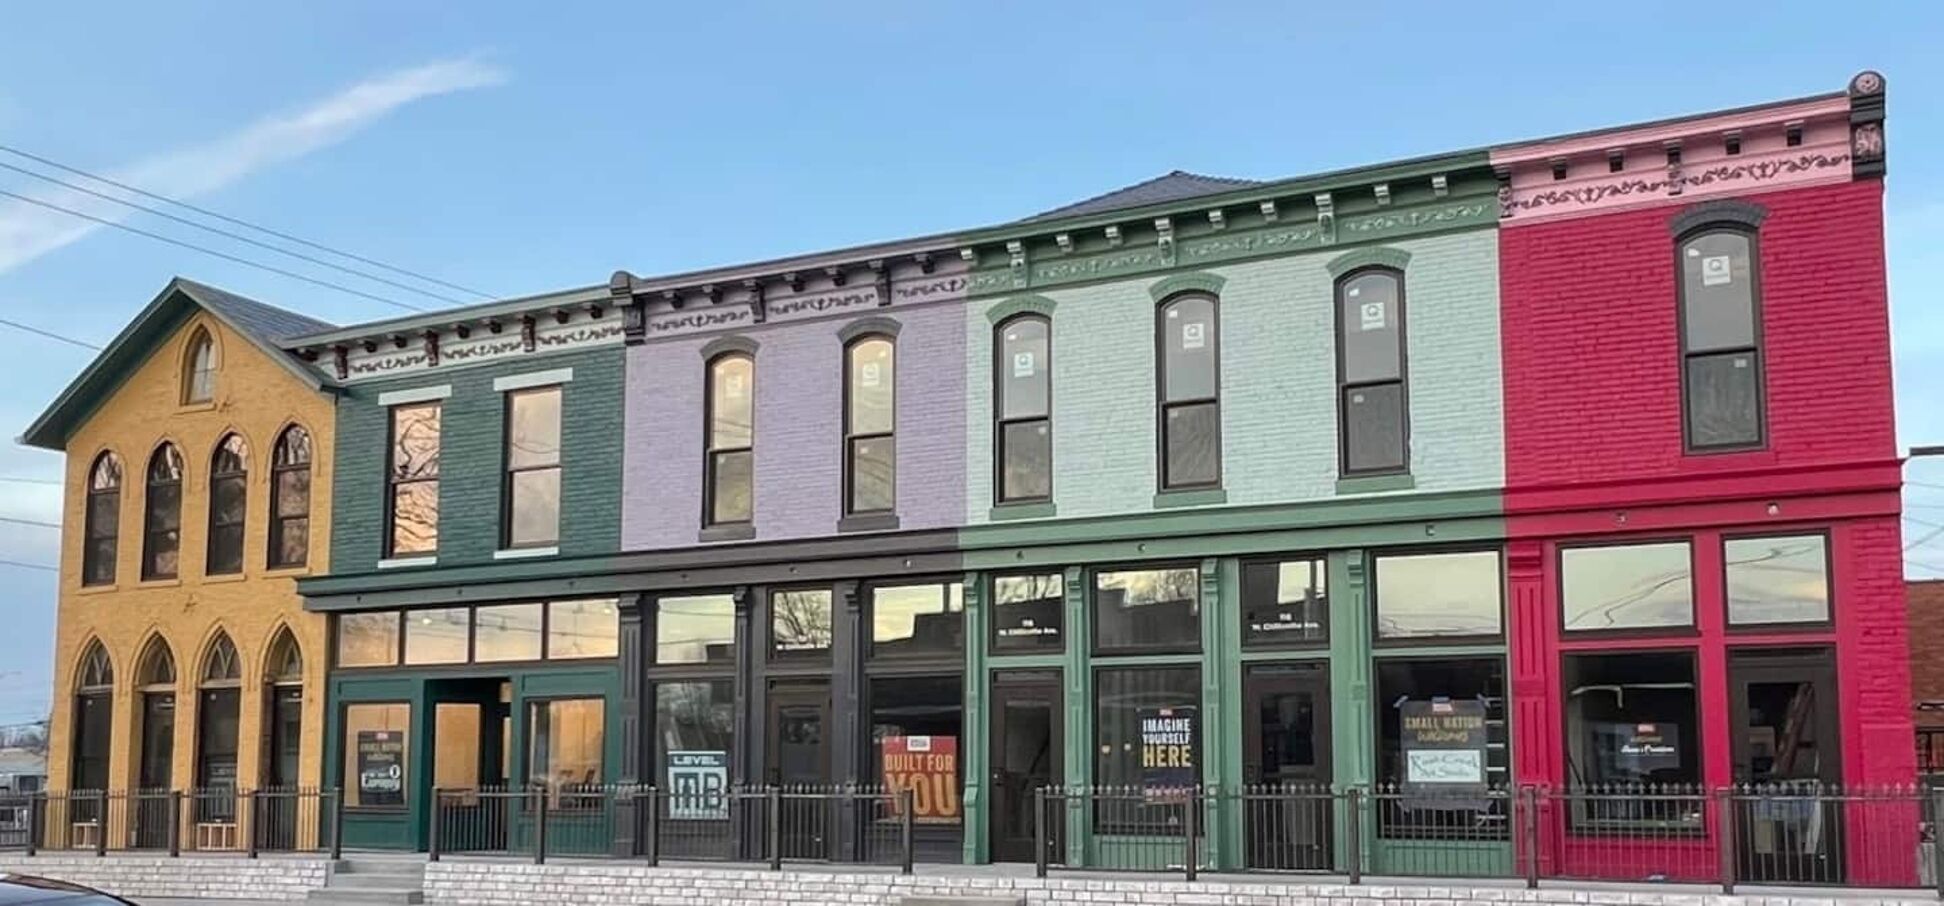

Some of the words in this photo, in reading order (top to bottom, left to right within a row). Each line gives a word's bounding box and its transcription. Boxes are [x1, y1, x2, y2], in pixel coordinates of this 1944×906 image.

[1142, 718, 1191, 732] IMAGINE
[1142, 732, 1191, 745] YOURSELF
[673, 756, 720, 765] LEVEL
[885, 754, 922, 771] BUILT
[927, 754, 953, 771] FOR
[1142, 745, 1192, 768] HERE
[885, 773, 957, 815] YOU
